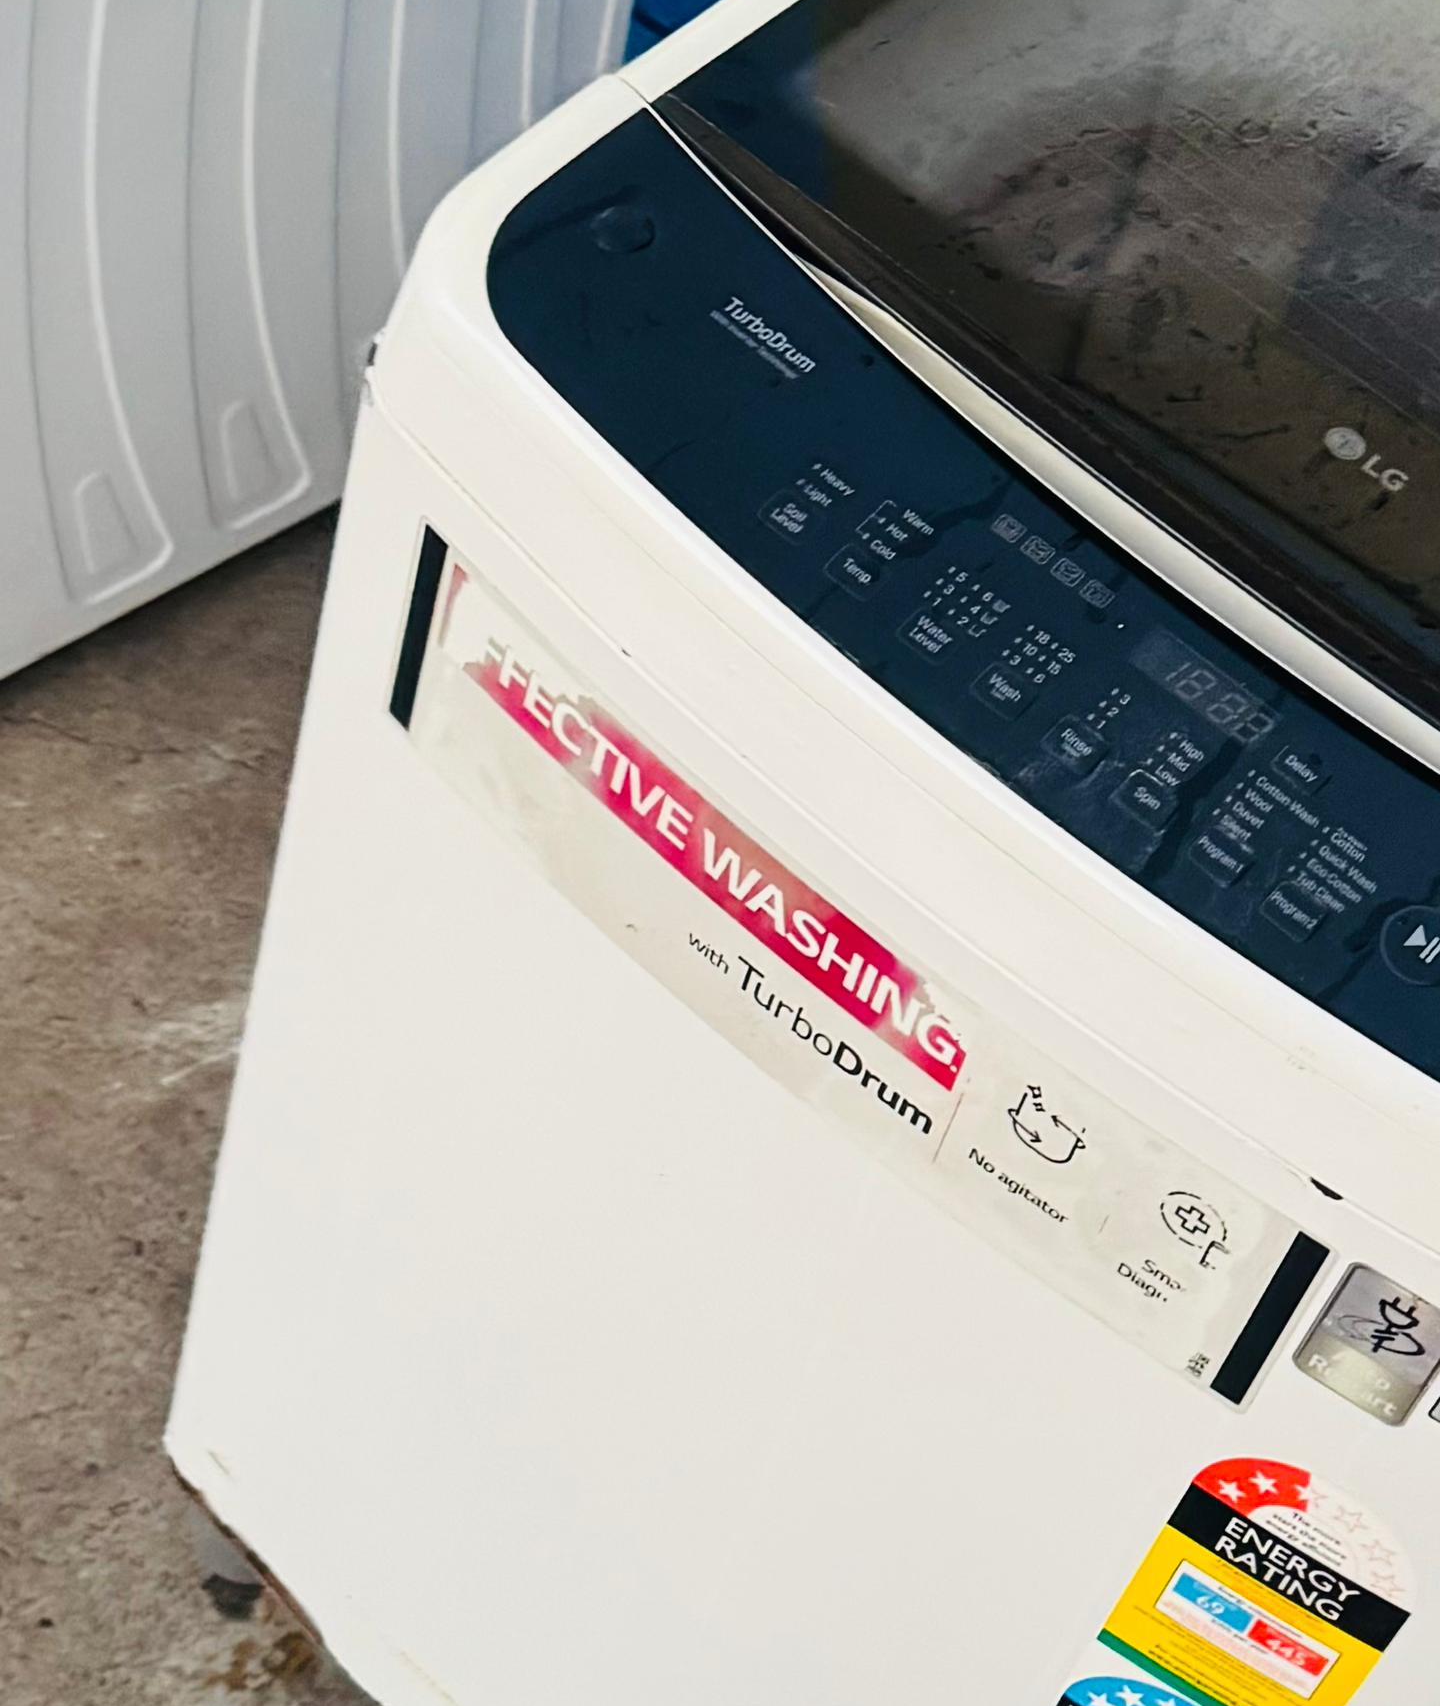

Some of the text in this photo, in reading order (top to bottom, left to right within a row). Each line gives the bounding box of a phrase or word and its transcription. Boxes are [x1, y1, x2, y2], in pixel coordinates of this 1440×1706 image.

[722, 295, 818, 373] TurboDrum
[819, 467, 856, 495] Heavy
[1359, 452, 1410, 494] LG
[802, 483, 833, 508] Light
[769, 506, 804, 535] Level
[782, 501, 809, 524] Soil
[901, 507, 935, 536] Warm
[884, 522, 909, 543] Hot
[868, 537, 897, 562] Cold
[942, 582, 981, 616] 3 4
[955, 570, 994, 603] 5 6
[930, 595, 969, 628] 1 2
[907, 626, 943, 655] Level
[916, 614, 954, 646] Water
[1008, 653, 1021, 667] 3
[1021, 641, 1062, 676] 10 15
[1033, 628, 1076, 665] 18 25
[988, 671, 1023, 702] Wash
[1118, 692, 1132, 707] 3
[1105, 704, 1120, 719] 2
[1059, 727, 1094, 756] Rinse
[1177, 738, 1205, 764] High
[1154, 763, 1181, 786] Low
[1166, 751, 1190, 773] Mid
[1283, 753, 1318, 783] Delay
[1132, 785, 1162, 812] Spin
[1243, 787, 1274, 813] Wool
[1254, 774, 1321, 829] Cotton Wash
[1219, 813, 1253, 842] Silent
[1231, 800, 1265, 829] Duvet
[1196, 834, 1235, 869] Program
[1328, 831, 1366, 863] Cotton
[1305, 856, 1363, 904] Eco Cotton
[1316, 844, 1379, 894] Quick Wash
[1295, 871, 1347, 914] Tub Clean
[686, 931, 936, 1136] with TurboDrum
[967, 1146, 1070, 1227] No agitator
[1223, 1515, 1362, 1608] ENERGY
[1213, 1533, 1345, 1623] RATING
[1194, 1590, 1226, 1618] 69
